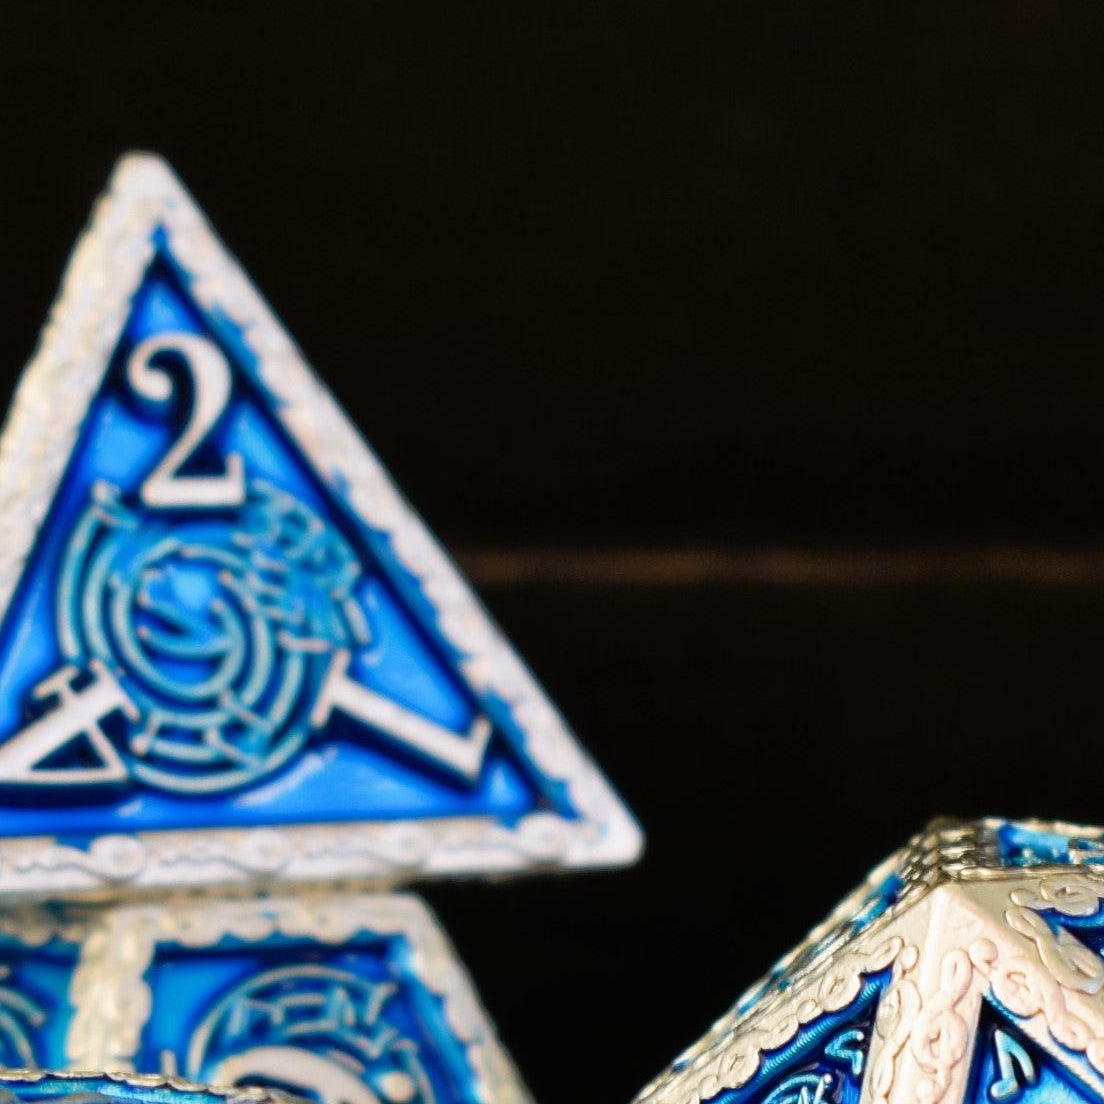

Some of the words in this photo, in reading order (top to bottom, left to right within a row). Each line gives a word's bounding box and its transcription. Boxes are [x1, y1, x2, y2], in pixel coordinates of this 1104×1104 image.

[126, 331, 247, 507] 2
[0, 658, 140, 783] 4
[311, 650, 492, 786] 1
